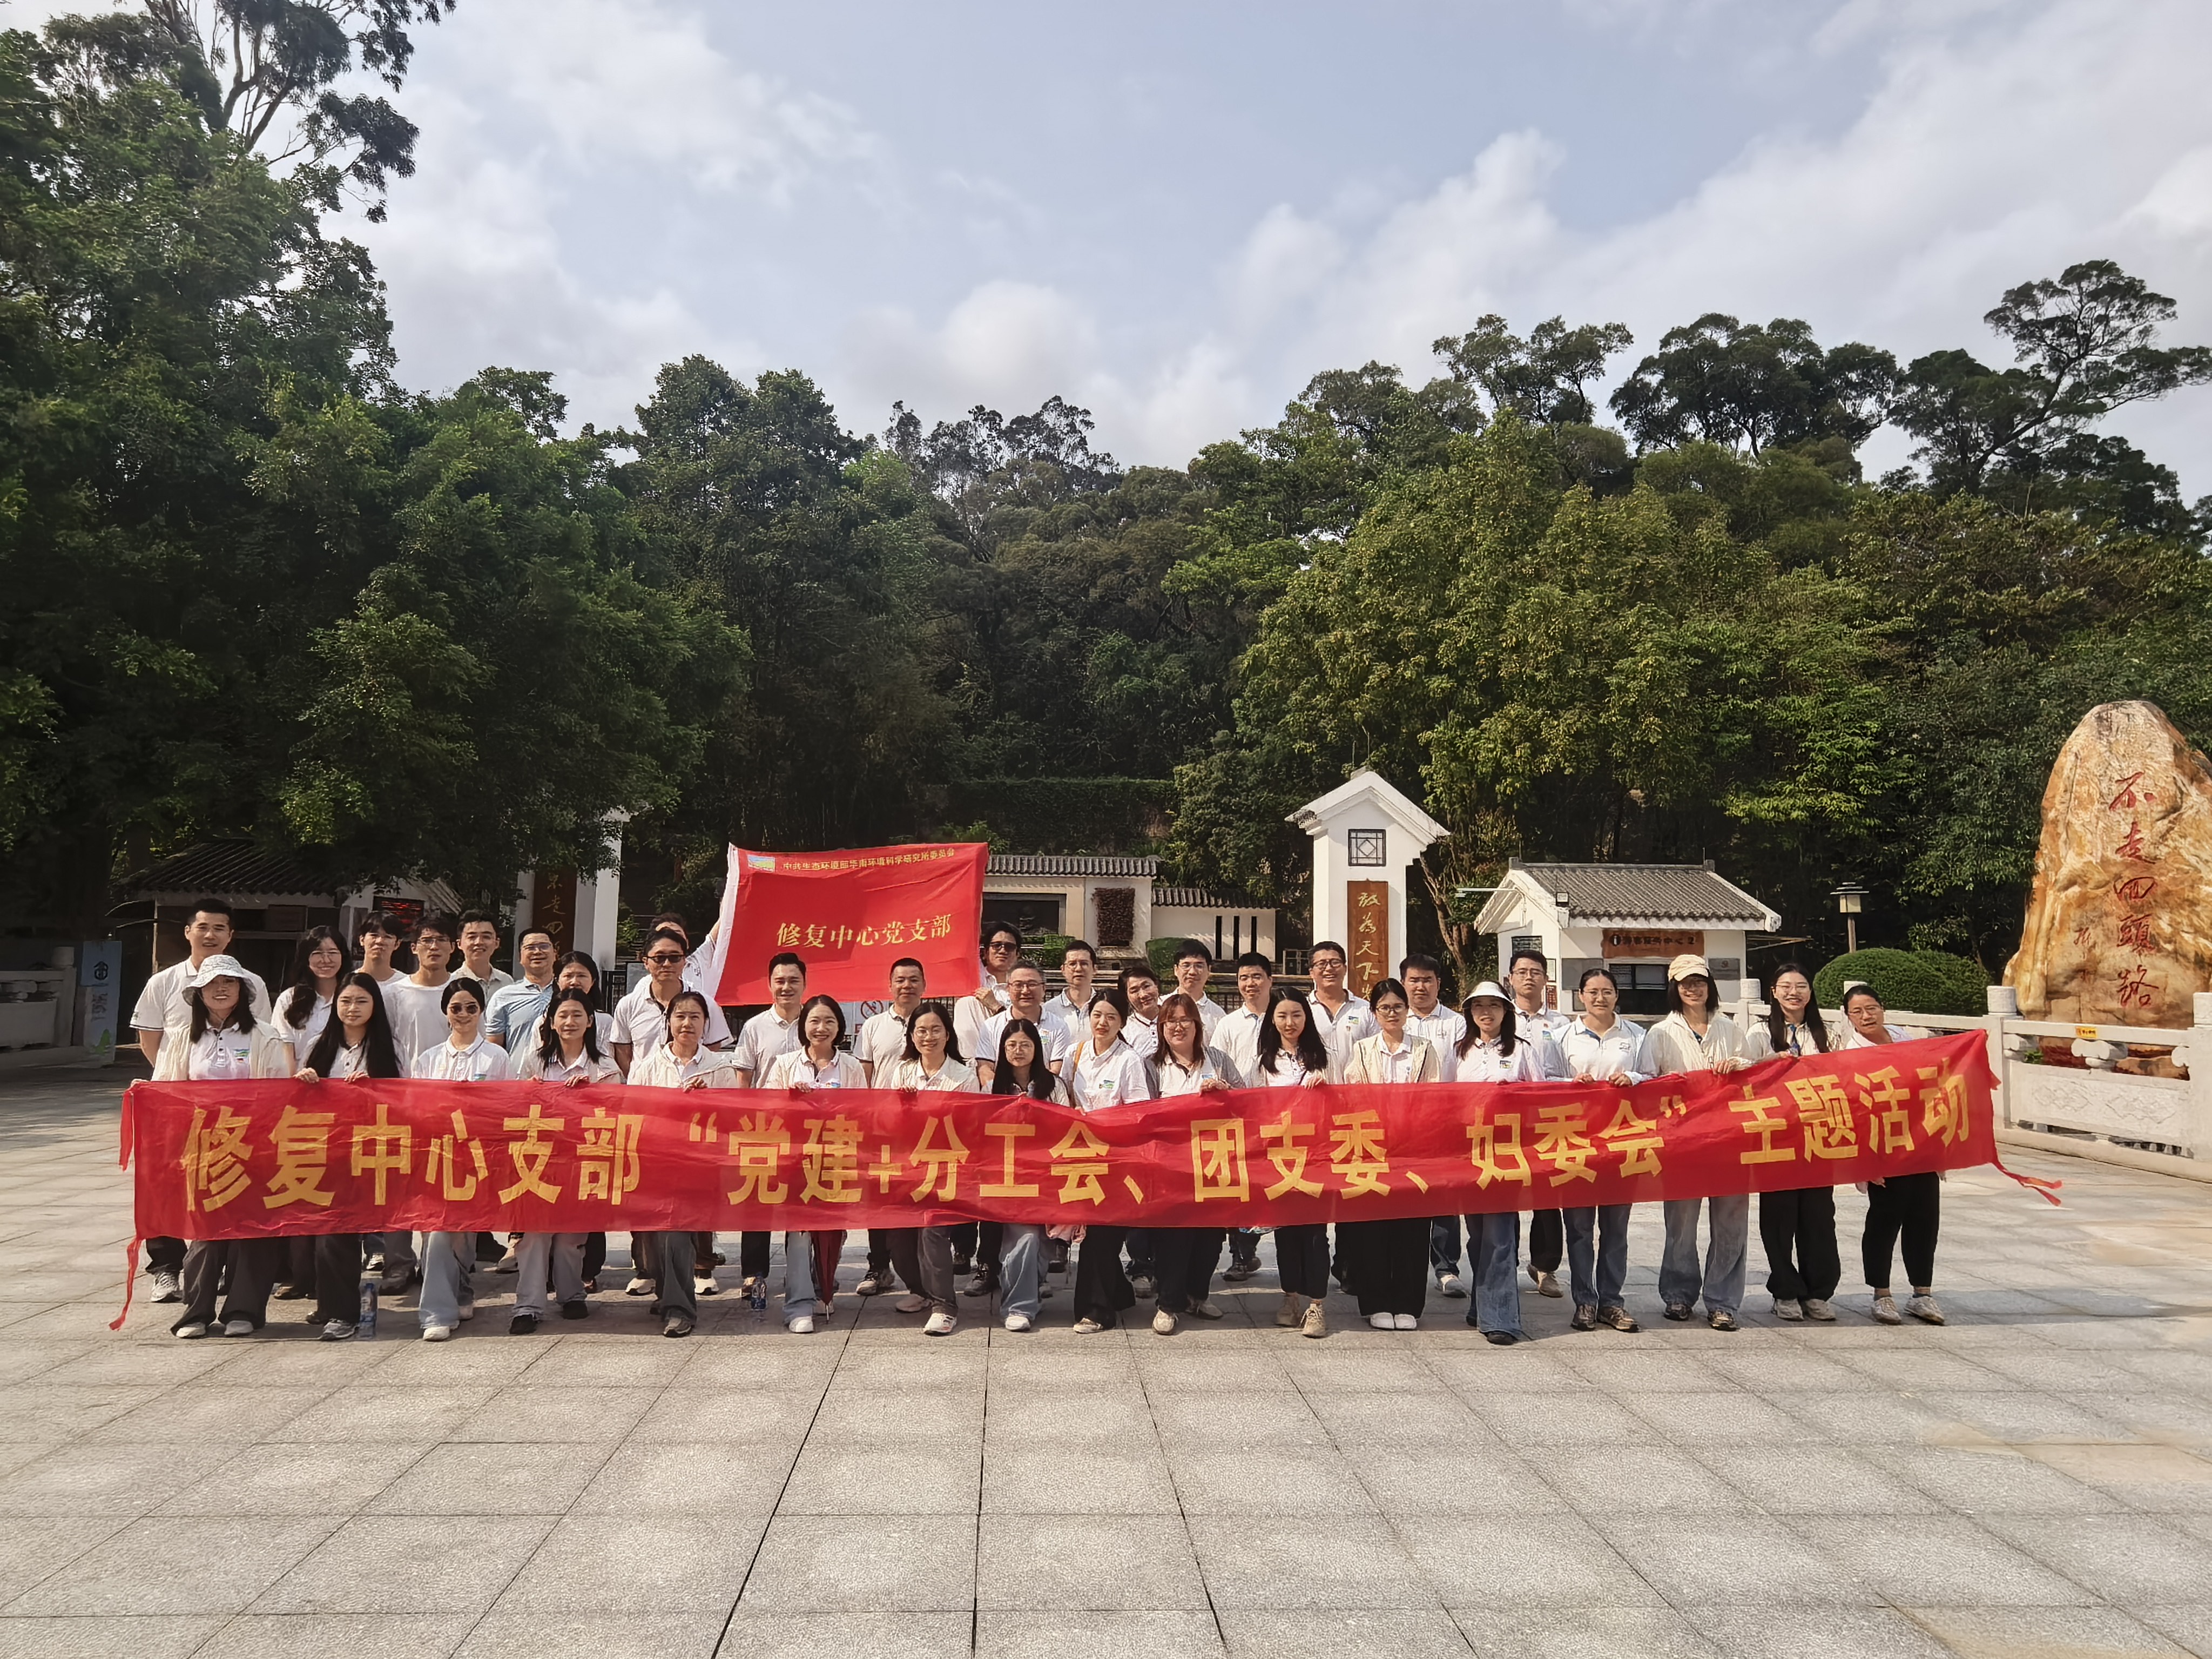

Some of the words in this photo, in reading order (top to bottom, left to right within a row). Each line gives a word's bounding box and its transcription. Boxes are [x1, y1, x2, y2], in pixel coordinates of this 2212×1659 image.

[777, 913, 952, 949] 修复中心党支部
